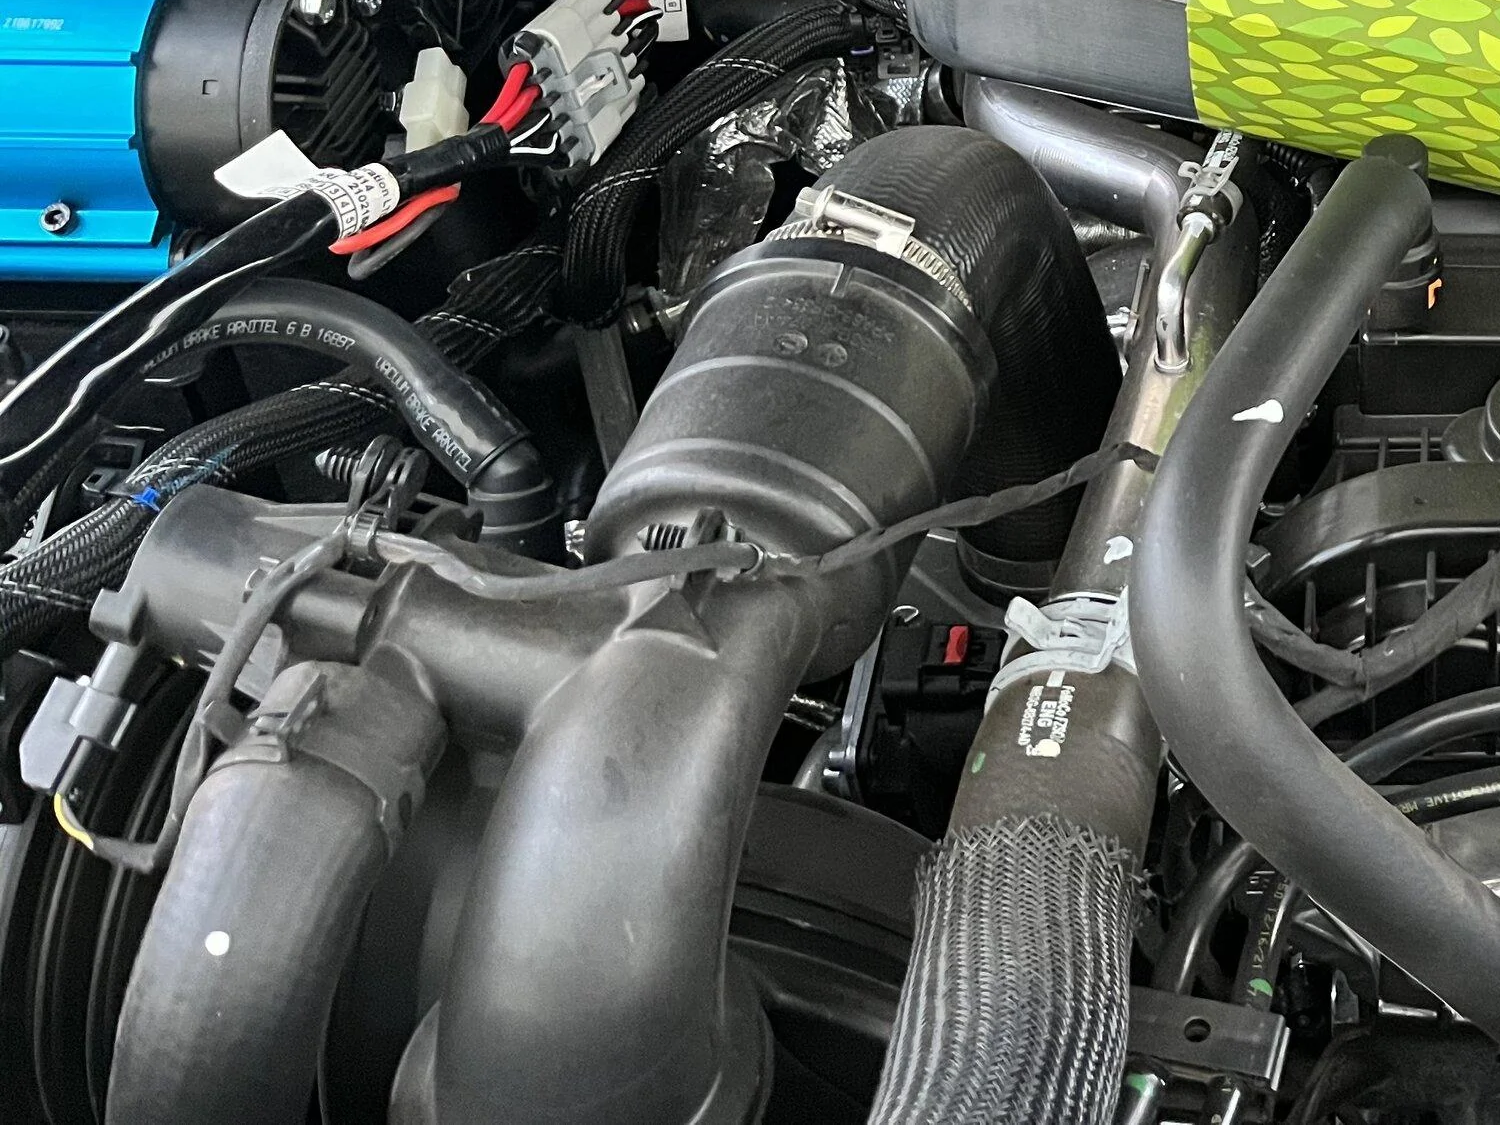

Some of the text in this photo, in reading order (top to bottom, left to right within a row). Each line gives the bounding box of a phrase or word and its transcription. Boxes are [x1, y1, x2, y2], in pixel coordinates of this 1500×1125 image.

[183, 324, 222, 351] BRAKE
[226, 318, 279, 335] ARNITEL
[285, 321, 296, 335] 6
[299, 322, 312, 337] B
[316, 327, 357, 352] 16897
[404, 393, 437, 433] BRAKE
[431, 427, 474, 473] ARNITEL
[1036, 700, 1058, 728] ENG
